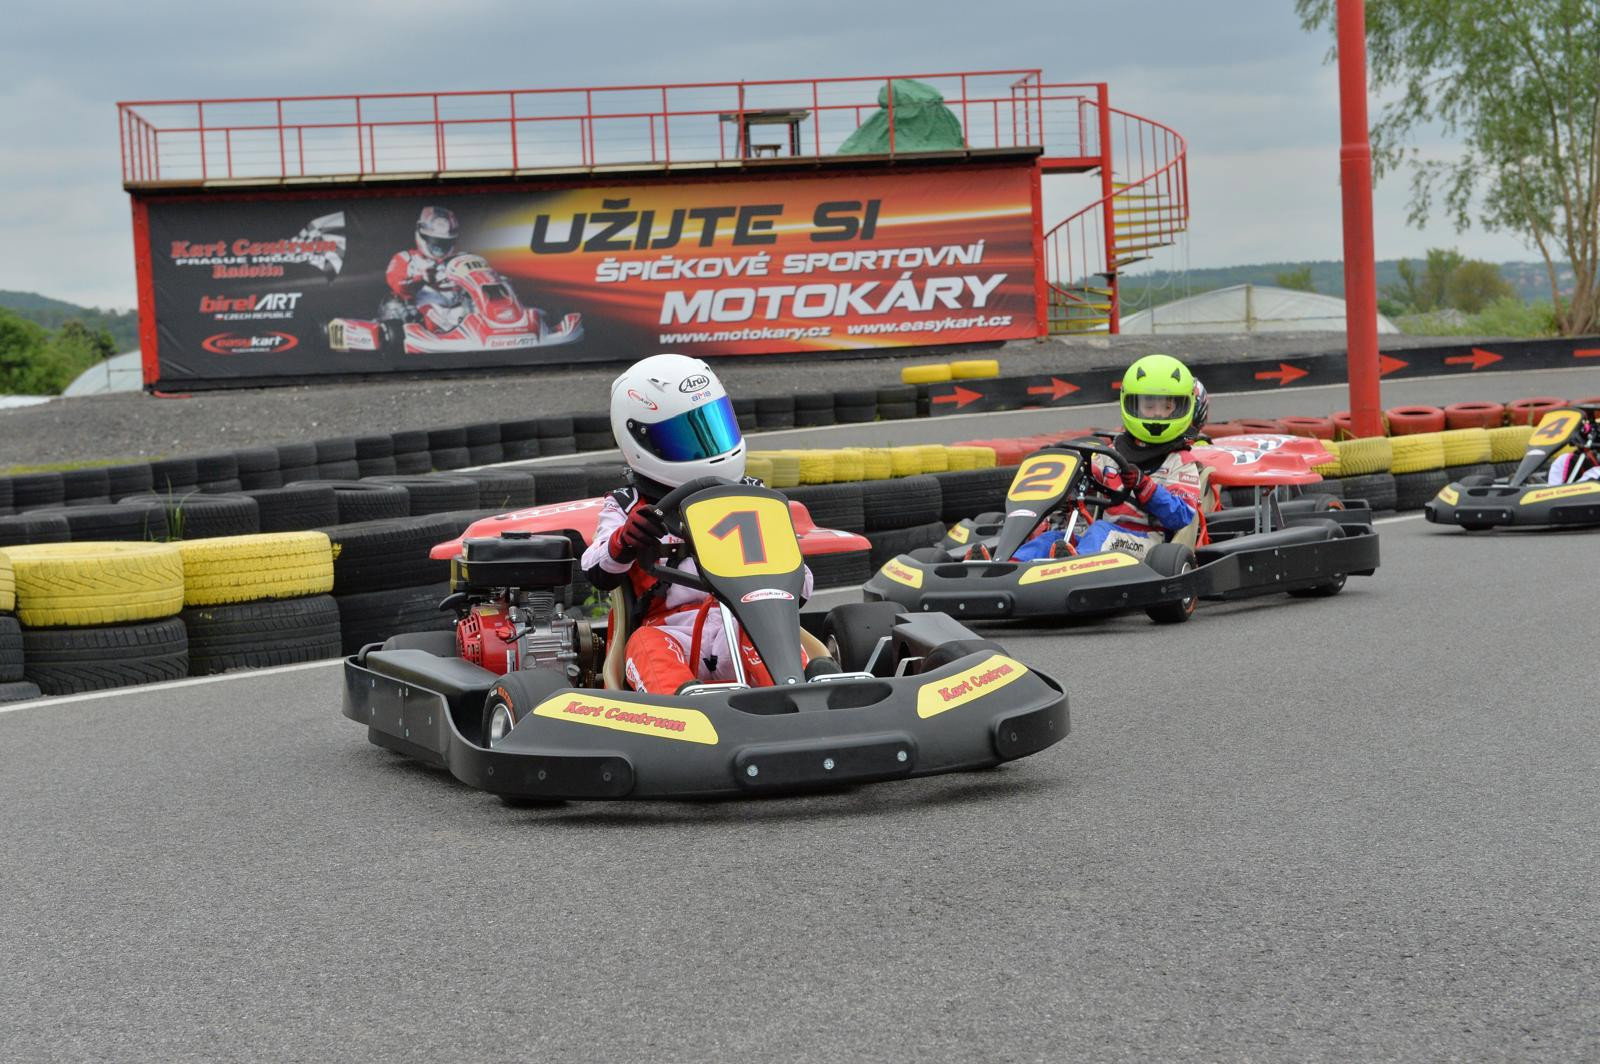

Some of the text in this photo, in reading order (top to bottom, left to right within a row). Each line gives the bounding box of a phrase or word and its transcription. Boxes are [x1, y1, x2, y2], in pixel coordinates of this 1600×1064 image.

[530, 197, 882, 254] UŽIJTE SI
[171, 240, 227, 259] Kart
[595, 239, 985, 283] ŠPIČKOVÉ SPORTOVNÍ
[199, 292, 303, 313] birelART
[659, 271, 1008, 325] MOTOKÁRY
[659, 314, 1013, 345] www.motokary.cz www.easykart.cz
[683, 375, 707, 392] Arai
[1536, 416, 1570, 438] 4
[1011, 461, 1065, 495] 2
[709, 510, 768, 565] 1
[562, 701, 687, 733] Kart Centrum
